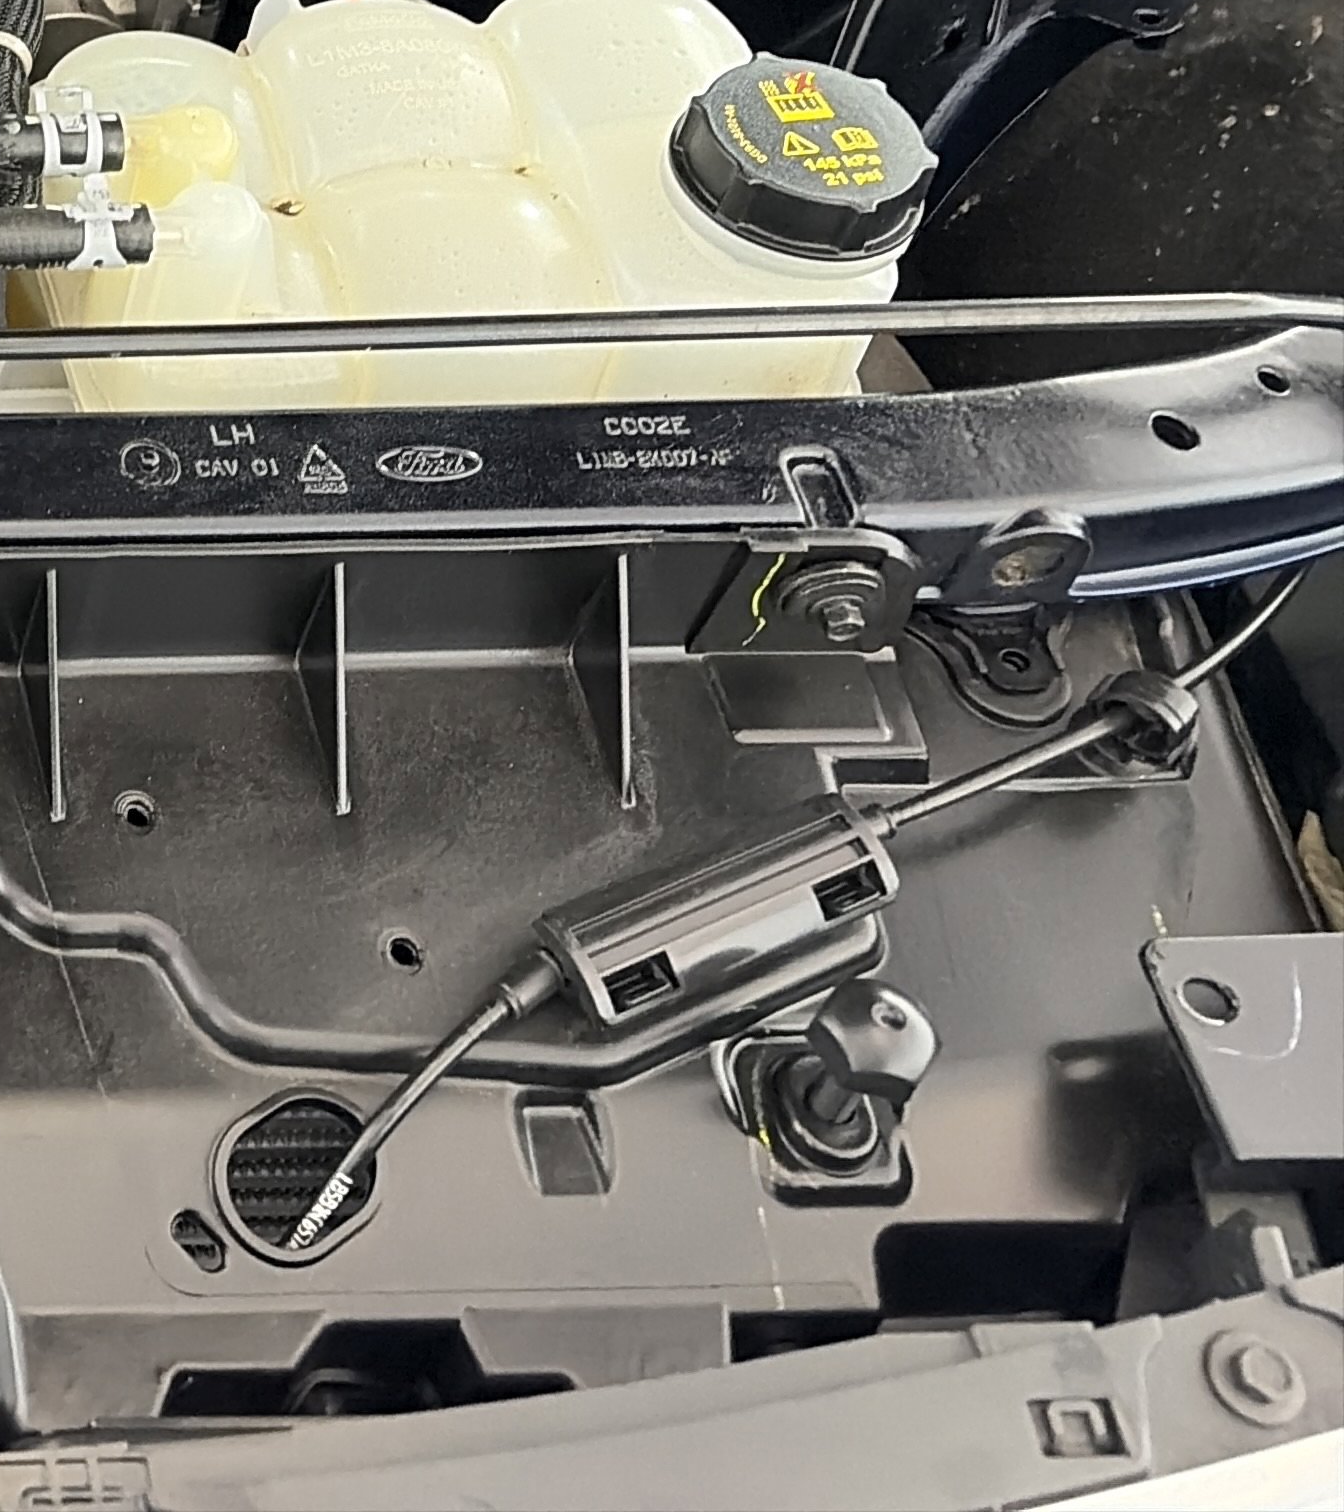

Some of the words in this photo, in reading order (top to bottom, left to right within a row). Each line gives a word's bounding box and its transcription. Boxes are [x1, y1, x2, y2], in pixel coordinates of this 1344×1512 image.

[803, 155, 840, 171] 145
[841, 153, 882, 168] kPa
[822, 171, 849, 186] 21
[209, 423, 255, 446] LH
[194, 458, 238, 478] CAV
[384, 448, 474, 479] Ford
